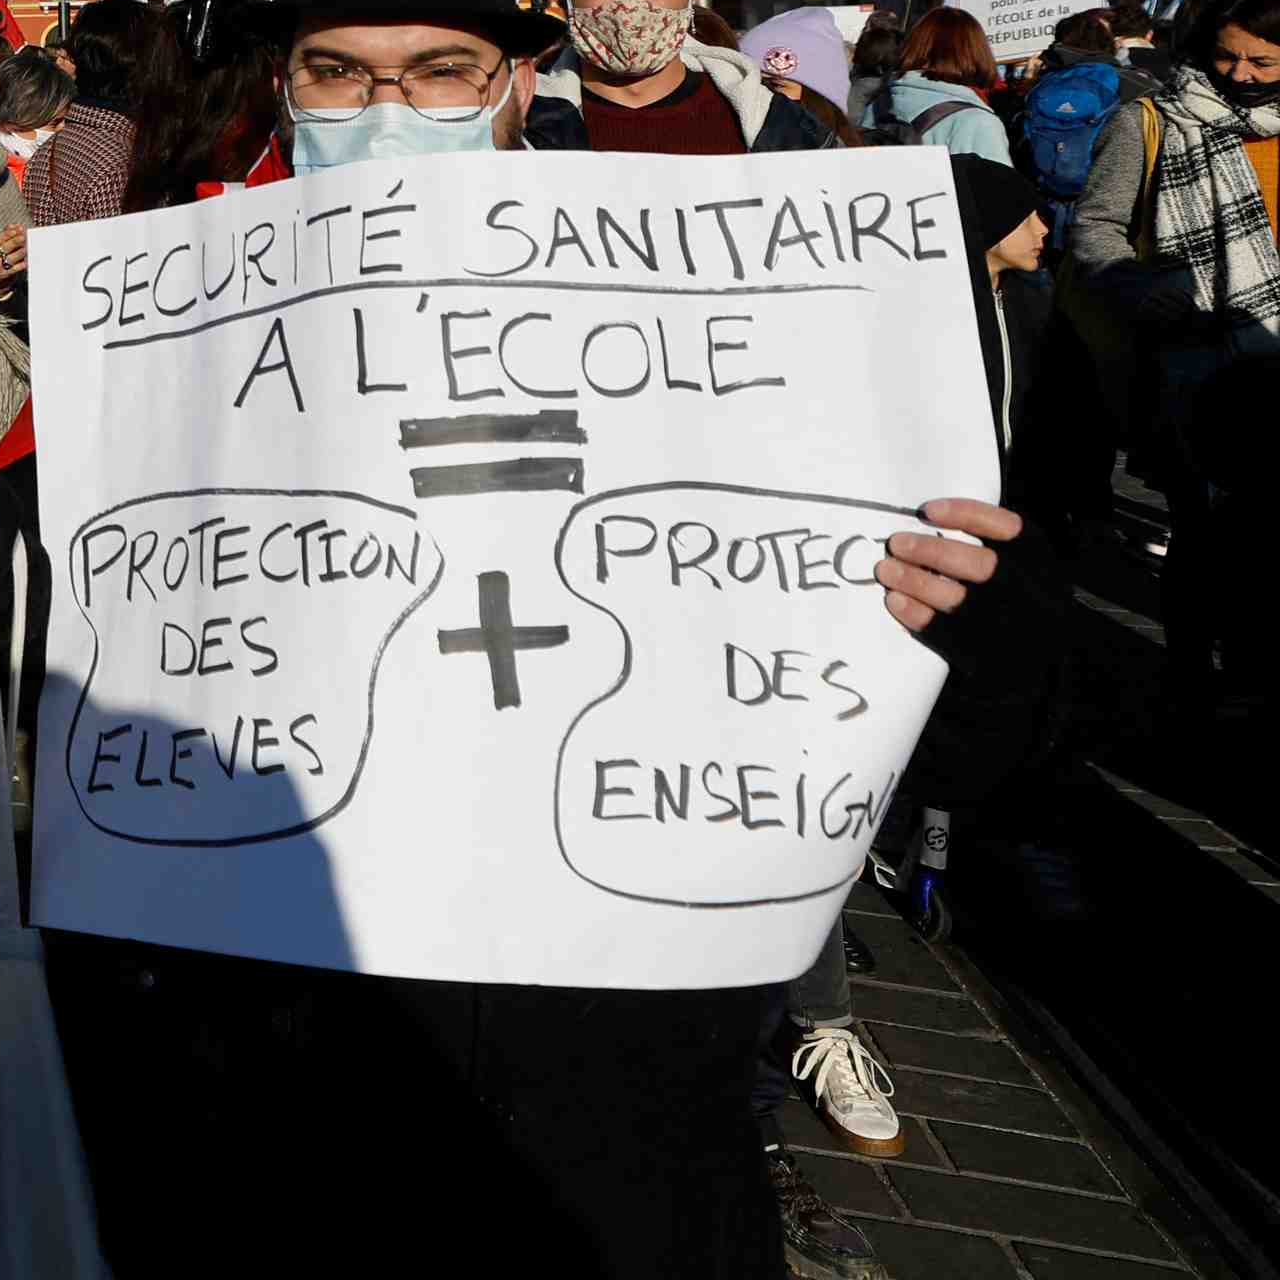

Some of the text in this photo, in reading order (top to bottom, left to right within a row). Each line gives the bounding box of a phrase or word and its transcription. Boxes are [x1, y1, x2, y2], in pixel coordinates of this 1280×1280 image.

[1038, 7, 1055, 18] de
[1059, 4, 1070, 16] la
[81, 179, 949, 332] SECURITÉ SANITAIRE
[232, 292, 786, 414] A L'ECOLE
[82, 517, 422, 608] PROTECTION
[595, 515, 887, 595] PROTEC
[159, 615, 278, 678] DES
[724, 642, 869, 722] DES
[86, 712, 326, 795] ELEVES
